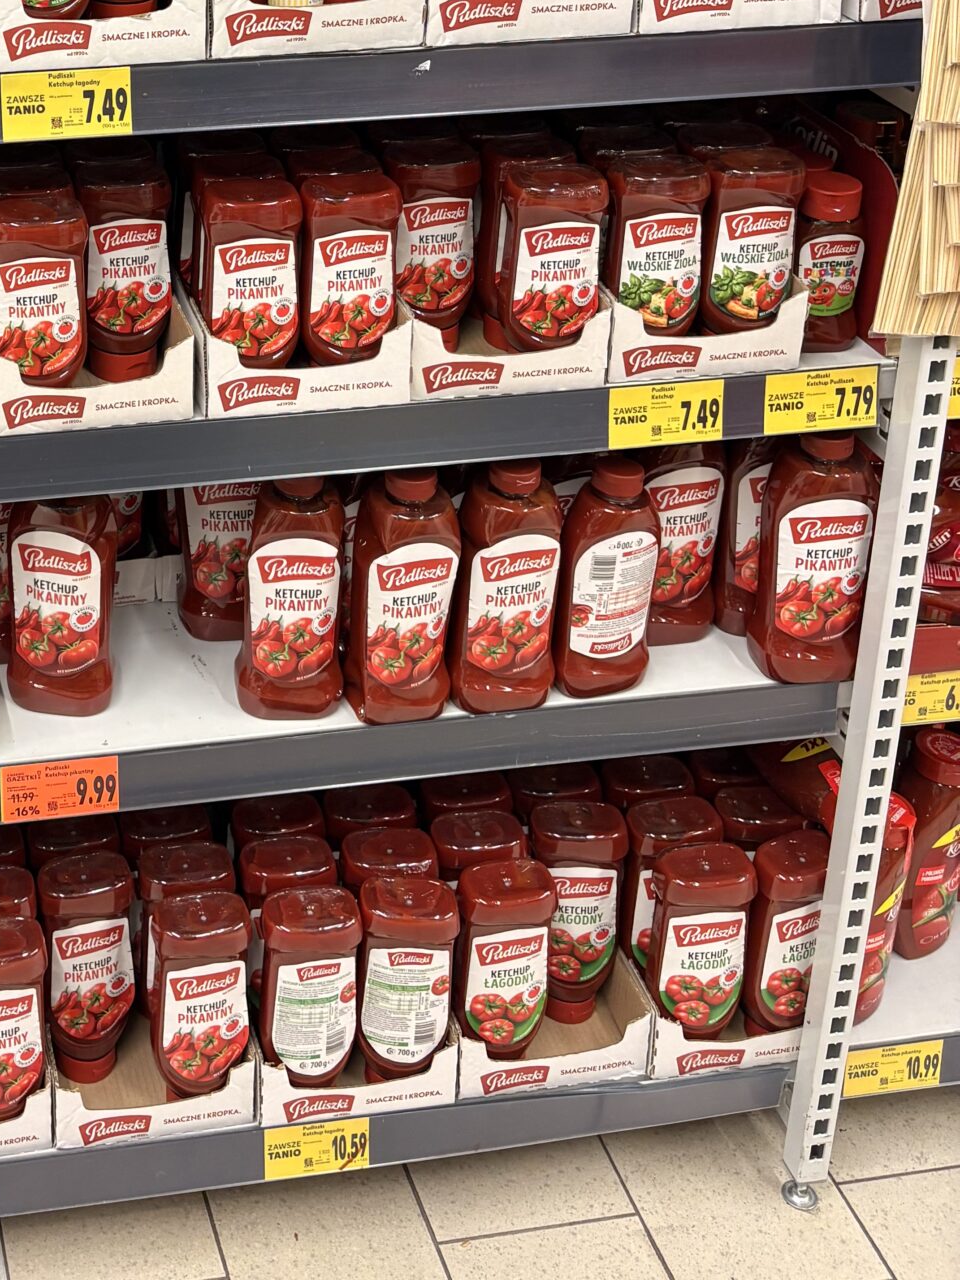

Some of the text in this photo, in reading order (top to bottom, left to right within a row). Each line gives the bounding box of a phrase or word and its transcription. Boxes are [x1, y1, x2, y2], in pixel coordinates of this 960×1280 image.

[11, 28, 85, 55] Pudliszki
[102, 32, 143, 42] SMACZNE
[152, 29, 190, 39] KROPKA.
[48, 78, 100, 88] Ketchup łagodny
[83, 88, 128, 123] 7.49
[739, 242, 779, 254] KETCHUP
[720, 249, 789, 264] WŁOSKIE ZIOŁA
[835, 385, 874, 418] 7.79
[613, 406, 647, 415] ZAWSZE
[680, 398, 720, 431] 7.49
[613, 414, 647, 425] TANIO
[806, 548, 853, 559] KETCHUP
[795, 556, 859, 571] PIKANTNY
[275, 589, 322, 600] KETCHUP
[265, 597, 329, 612] PIKANTNY
[77, 774, 116, 805] 9.99
[11, 792, 34, 803] 11.99
[10, 805, 40, 816] -16%
[178, 1004, 235, 1024] PIKANTNY
[186, 999, 227, 1014] KETCHUP
[398, 1048, 410, 1056] 700
[906, 1052, 939, 1080] 10.99
[163, 1114, 201, 1125] SMACZNE
[207, 1109, 241, 1119] KROPKA.
